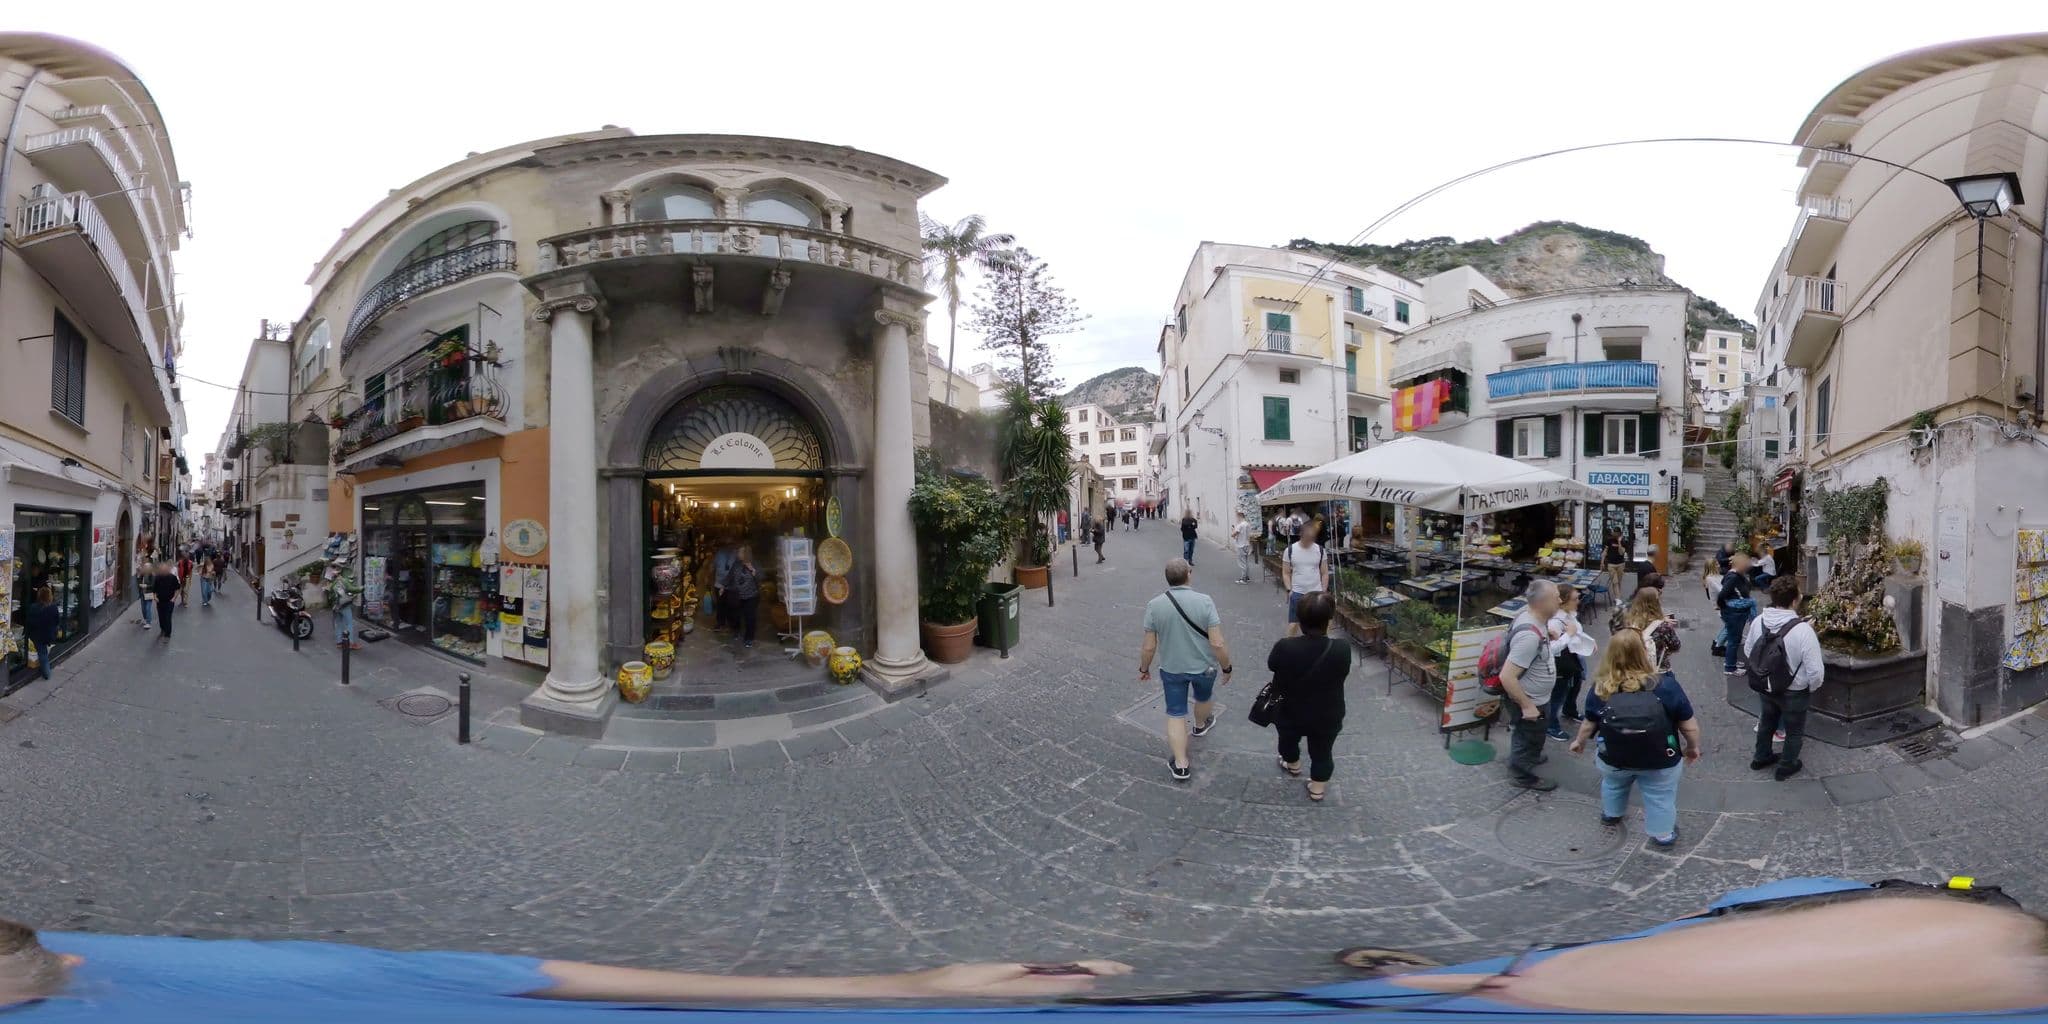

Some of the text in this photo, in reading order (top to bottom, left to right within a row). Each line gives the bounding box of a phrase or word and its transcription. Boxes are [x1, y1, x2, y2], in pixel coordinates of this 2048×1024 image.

[711, 438, 763, 459] Le Colonne
[1330, 474, 1354, 494] del
[1590, 473, 1649, 485] TABACCHI
[1469, 487, 1529, 511] TRATTORIA
